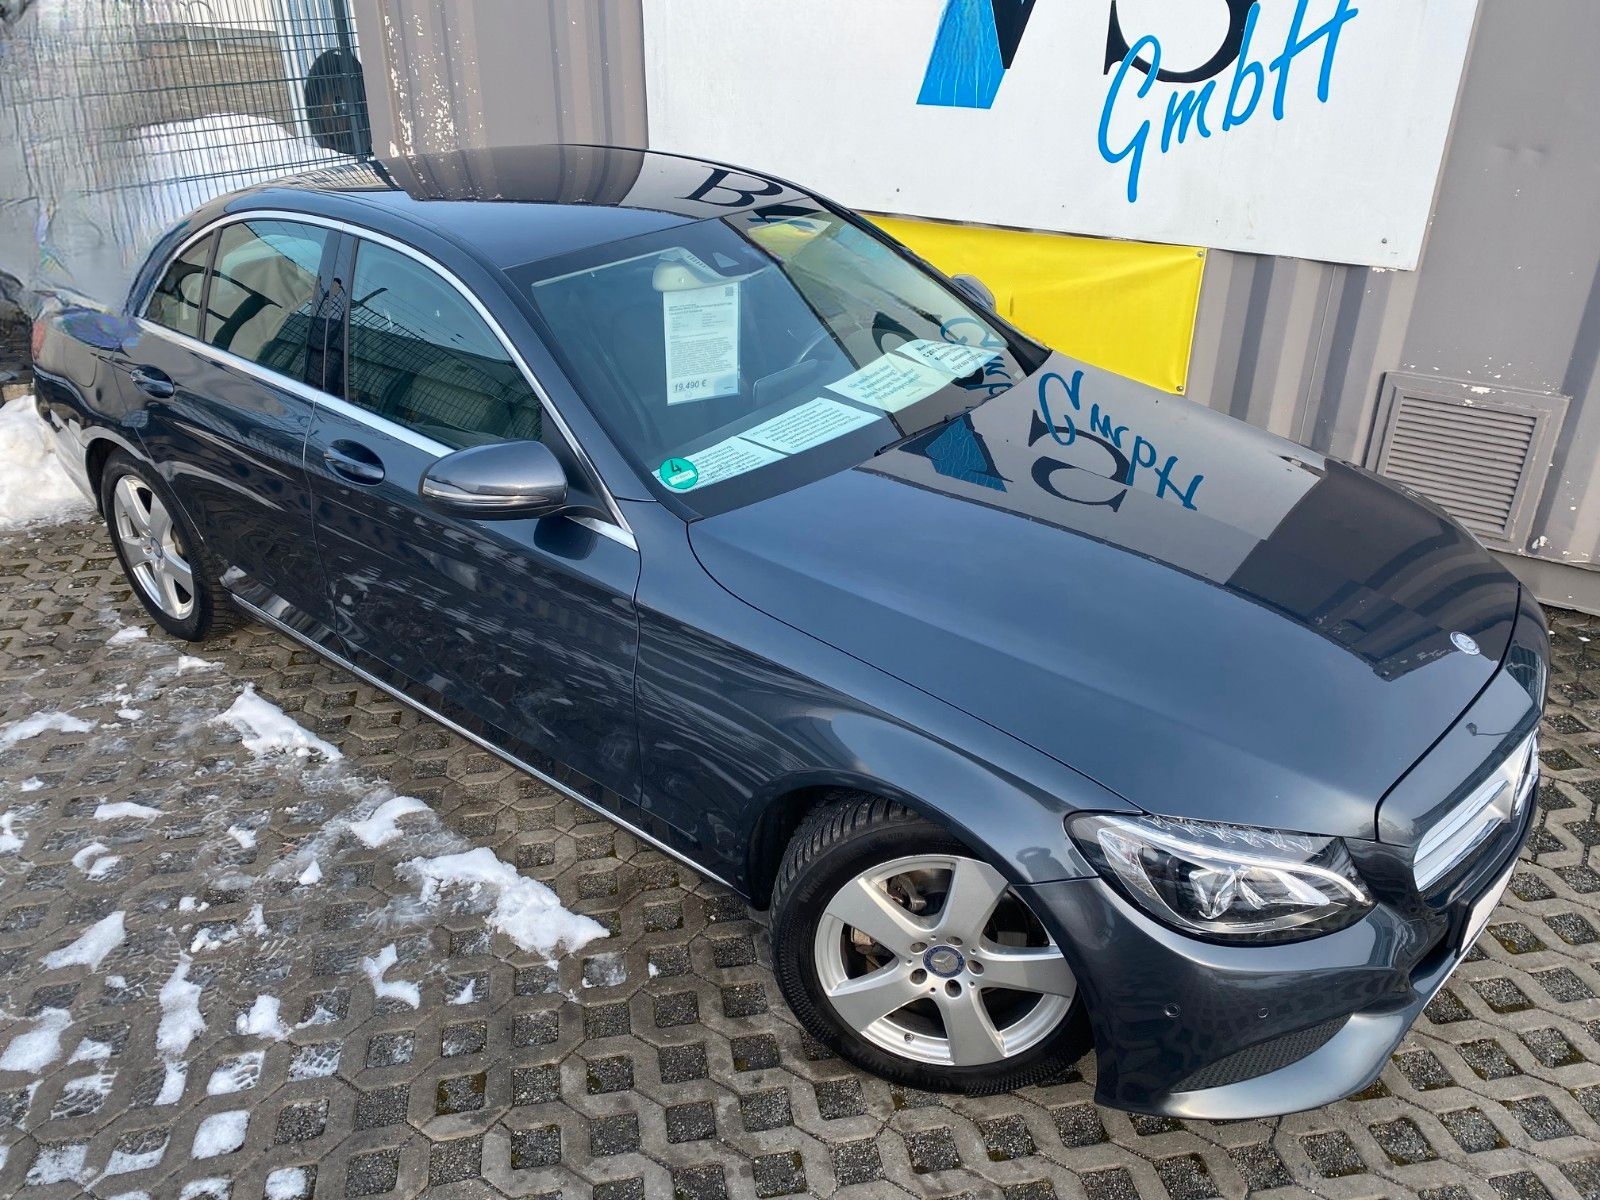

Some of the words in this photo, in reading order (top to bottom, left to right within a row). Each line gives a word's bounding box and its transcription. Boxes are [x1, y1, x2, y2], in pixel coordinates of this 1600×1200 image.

[1098, 0, 1358, 203] GmbH
[673, 381, 700, 392] 19.490
[670, 460, 682, 473] 4
